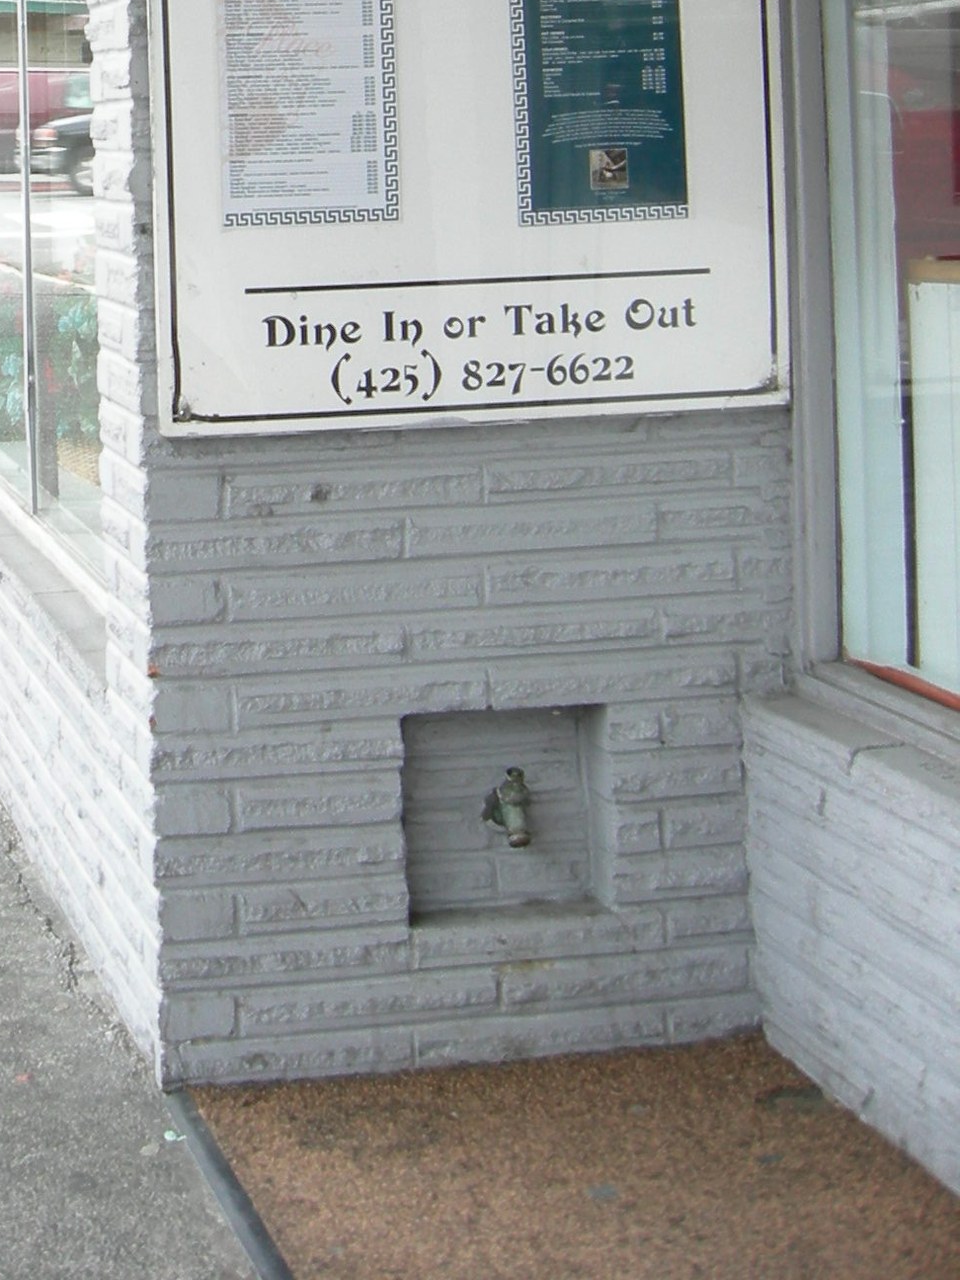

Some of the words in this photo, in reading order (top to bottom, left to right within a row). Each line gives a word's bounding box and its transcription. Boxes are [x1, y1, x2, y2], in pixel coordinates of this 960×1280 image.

[261, 313, 363, 352] Dine
[382, 309, 424, 348] In
[442, 320, 486, 340] or
[504, 302, 606, 339] Take
[624, 296, 697, 331] Out
[330, 348, 442, 406] (425)
[461, 352, 635, 395] 827-6622
